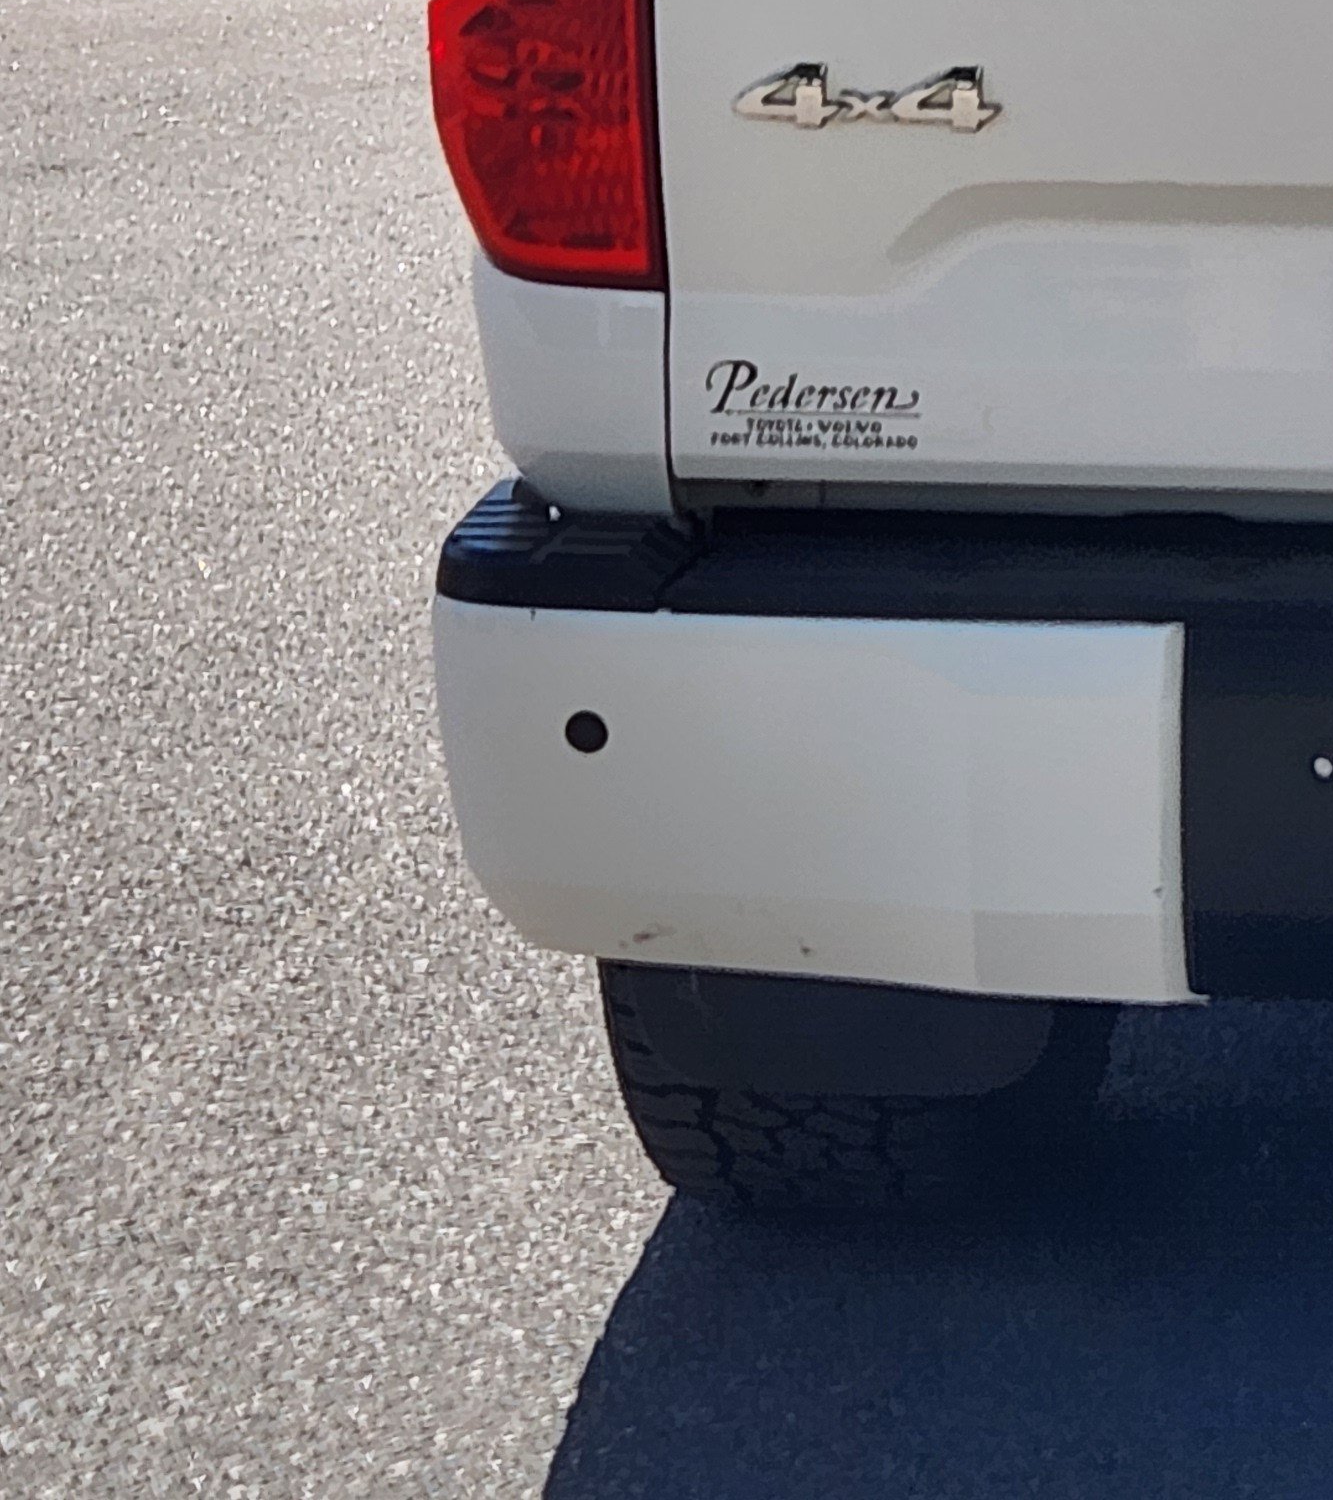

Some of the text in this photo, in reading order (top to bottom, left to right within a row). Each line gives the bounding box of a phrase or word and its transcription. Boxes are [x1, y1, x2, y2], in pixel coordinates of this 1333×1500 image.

[732, 62, 1003, 134] 4x4
[706, 360, 920, 414] Pedersen
[746, 417, 882, 434] TOYOTA VOLVO
